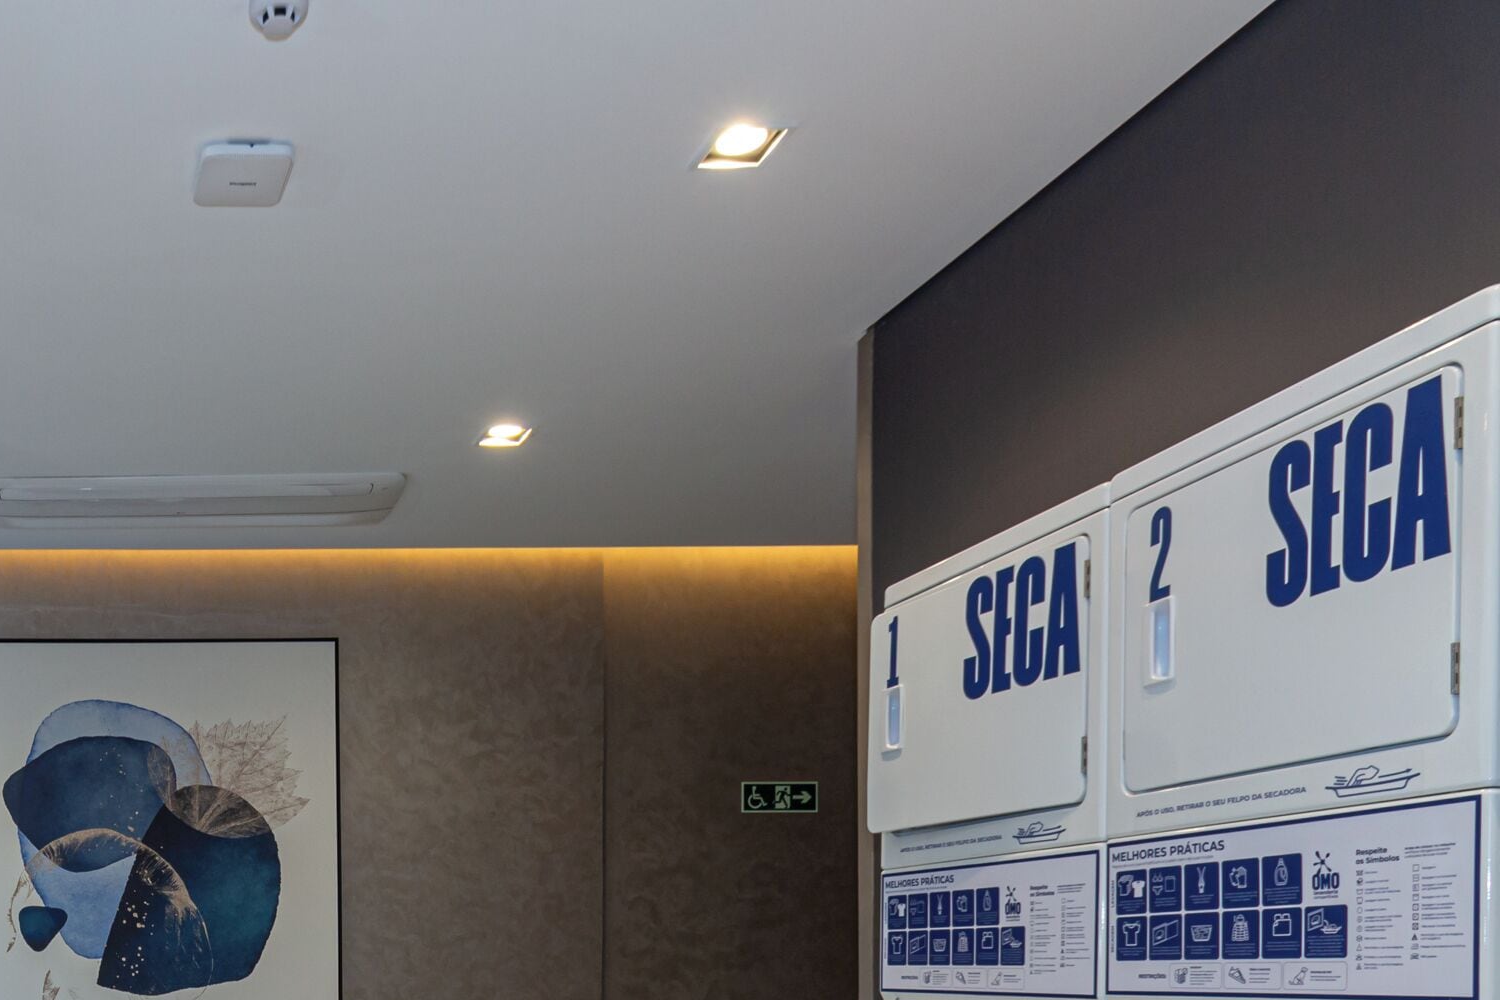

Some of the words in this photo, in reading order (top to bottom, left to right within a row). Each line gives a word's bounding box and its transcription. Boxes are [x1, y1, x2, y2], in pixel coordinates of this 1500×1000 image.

[1266, 374, 1451, 607] SECA
[1149, 506, 1173, 603] 2
[963, 542, 1081, 700] SECA
[886, 615, 900, 688] 1
[1264, 786, 1307, 799] SECADORA
[1112, 847, 1167, 863] MELHORES
[1170, 840, 1225, 856] PRÁTICAS
[885, 878, 919, 889] MELHORES
[921, 874, 954, 886] PRÁTICAS
[1312, 872, 1340, 890] OMO
